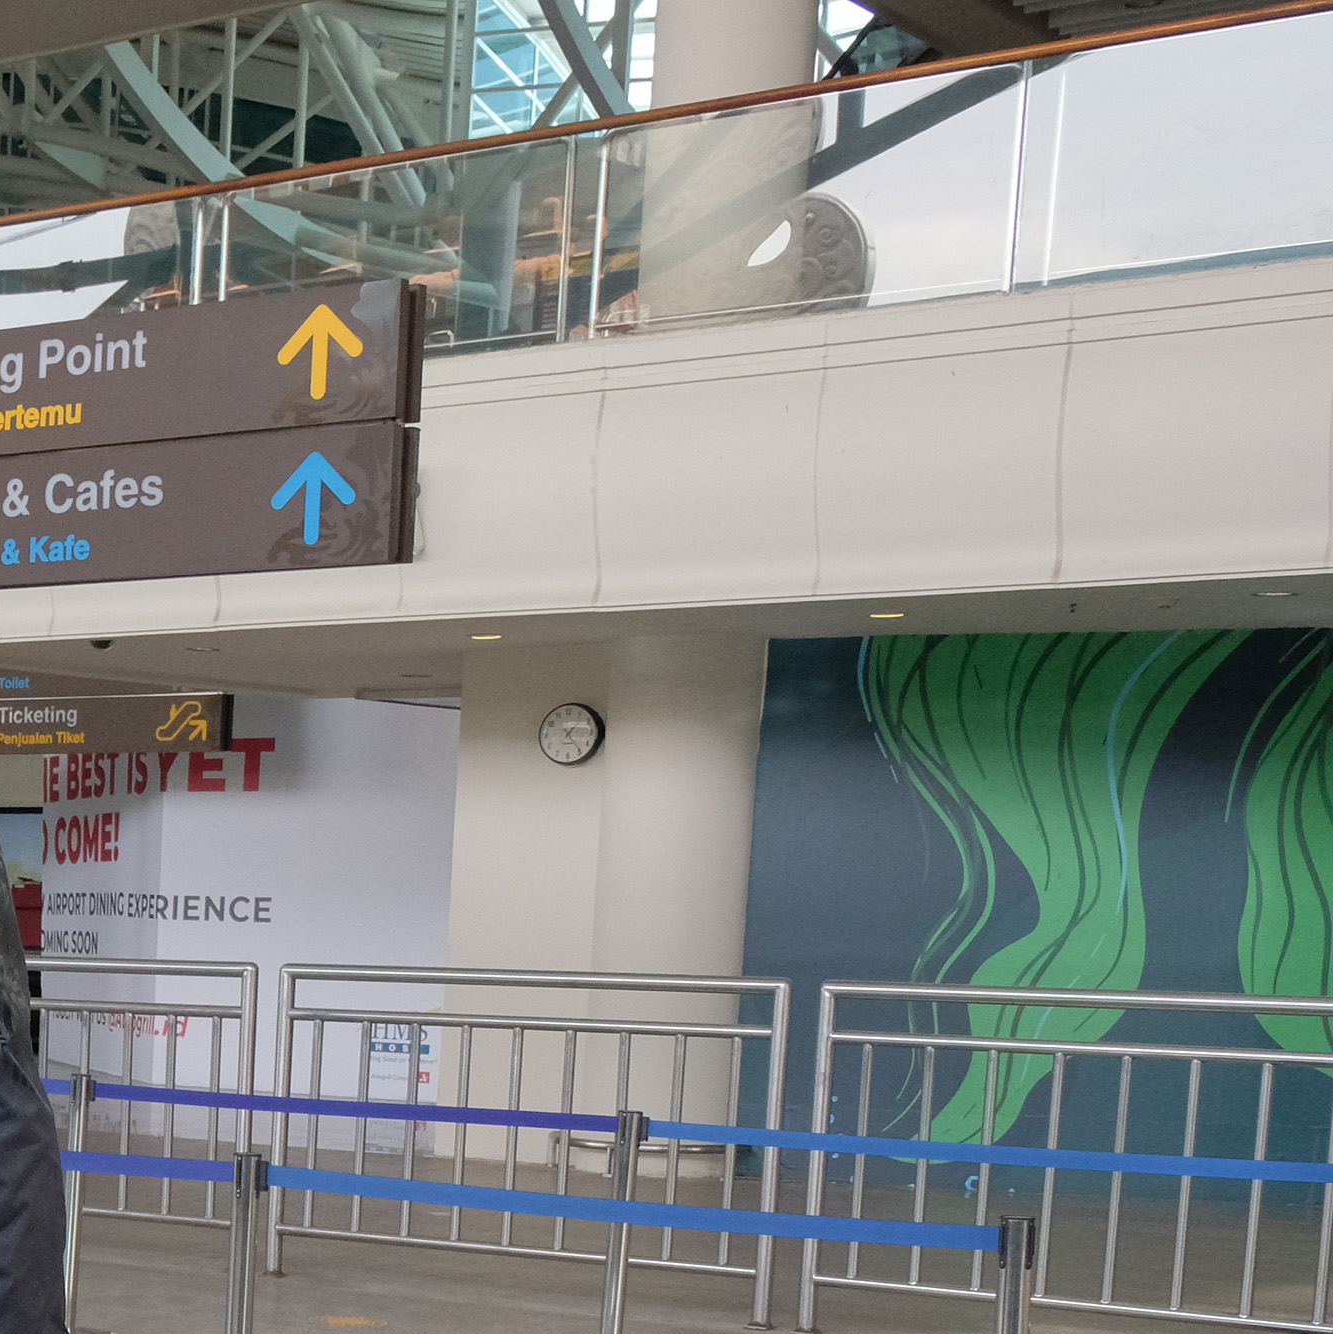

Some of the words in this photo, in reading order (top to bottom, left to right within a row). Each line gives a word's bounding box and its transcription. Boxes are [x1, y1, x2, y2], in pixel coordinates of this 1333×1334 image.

[38, 331, 147, 379] Point
[2, 478, 30, 517] &
[44, 469, 164, 514] Cafes
[1, 538, 20, 565] &
[29, 534, 90, 563] Kafe
[56, 731, 85, 744] Tiket
[66, 753, 120, 800] BEST
[127, 753, 148, 795] IS
[158, 738, 276, 792] YET
[54, 812, 120, 865] COME!
[47, 892, 86, 916] AIRPORT
[89, 892, 124, 916] DINING
[127, 893, 273, 923] EXPERIENCE
[41, 929, 69, 953] OMING
[71, 931, 98, 955] SOON
